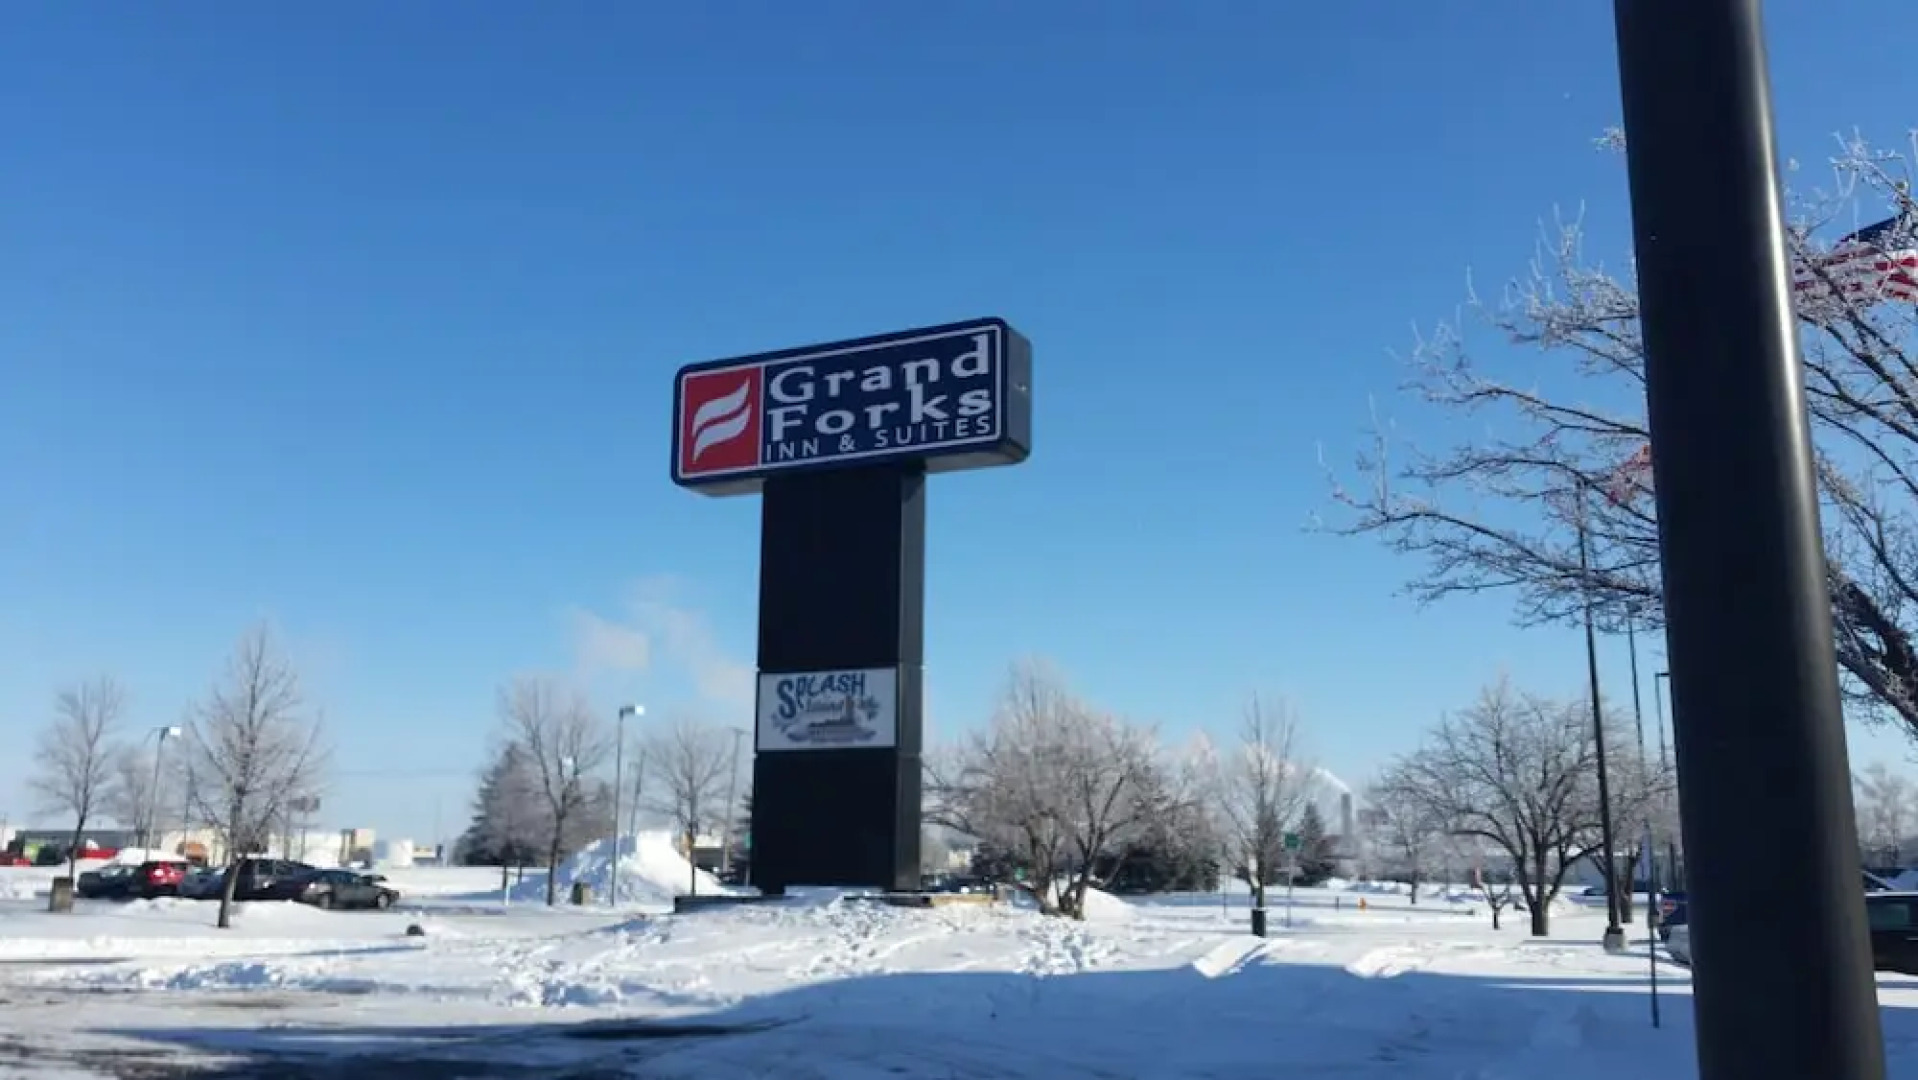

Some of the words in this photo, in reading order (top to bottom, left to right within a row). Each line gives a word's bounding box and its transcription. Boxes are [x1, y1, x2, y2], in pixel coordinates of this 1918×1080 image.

[769, 333, 990, 403] Grand
[766, 437, 819, 461] INN
[839, 434, 856, 451] &
[875, 415, 991, 448] SUITES
[767, 383, 992, 441] Forks
[777, 673, 866, 719] SPLASH
